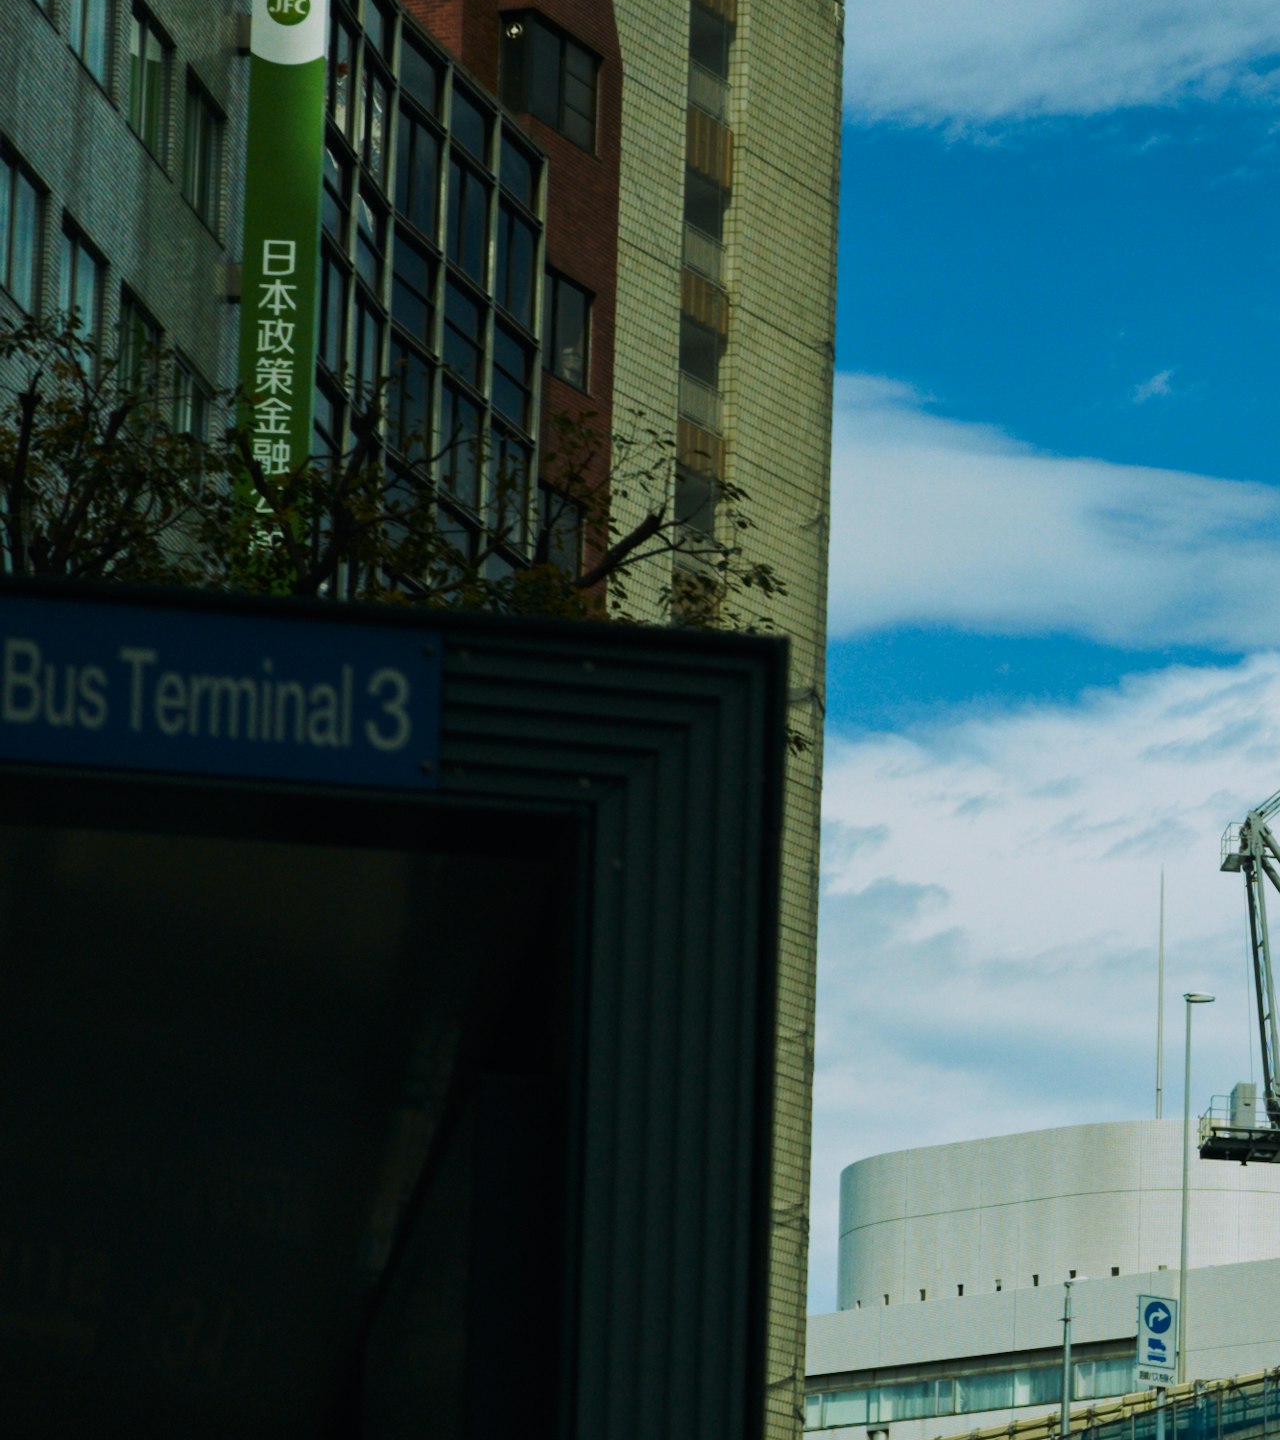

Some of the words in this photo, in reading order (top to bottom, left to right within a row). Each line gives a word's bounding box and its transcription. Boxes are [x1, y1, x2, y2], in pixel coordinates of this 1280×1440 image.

[2, 636, 109, 730] Bus
[118, 644, 354, 751] Terminal
[363, 665, 414, 754] 3
